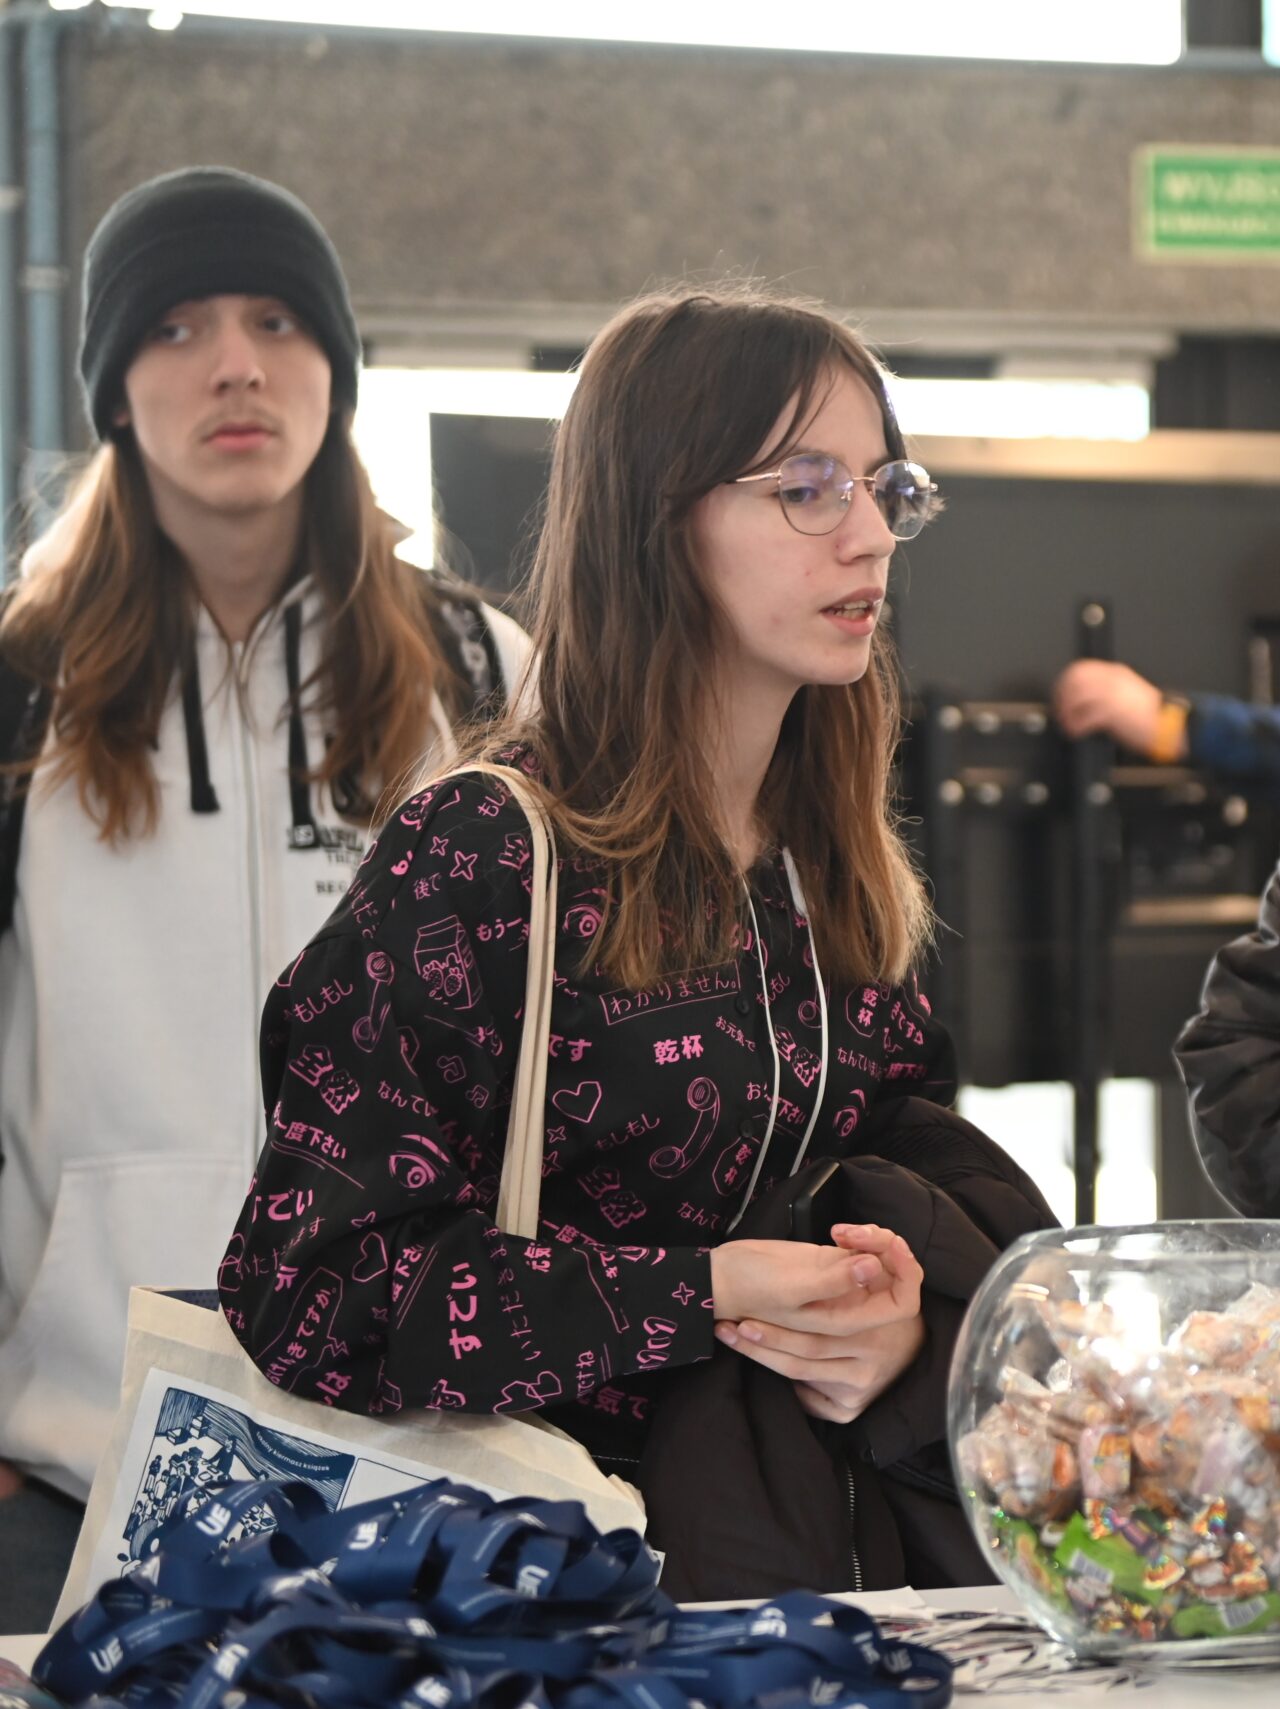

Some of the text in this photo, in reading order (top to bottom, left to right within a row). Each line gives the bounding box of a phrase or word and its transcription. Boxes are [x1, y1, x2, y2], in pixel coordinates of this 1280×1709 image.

[293, 979, 353, 1022] もしもし
[653, 1034, 705, 1065] 乾杯
[195, 1503, 232, 1538] UE
[349, 1521, 379, 1550] UE
[90, 1636, 124, 1674] UE
